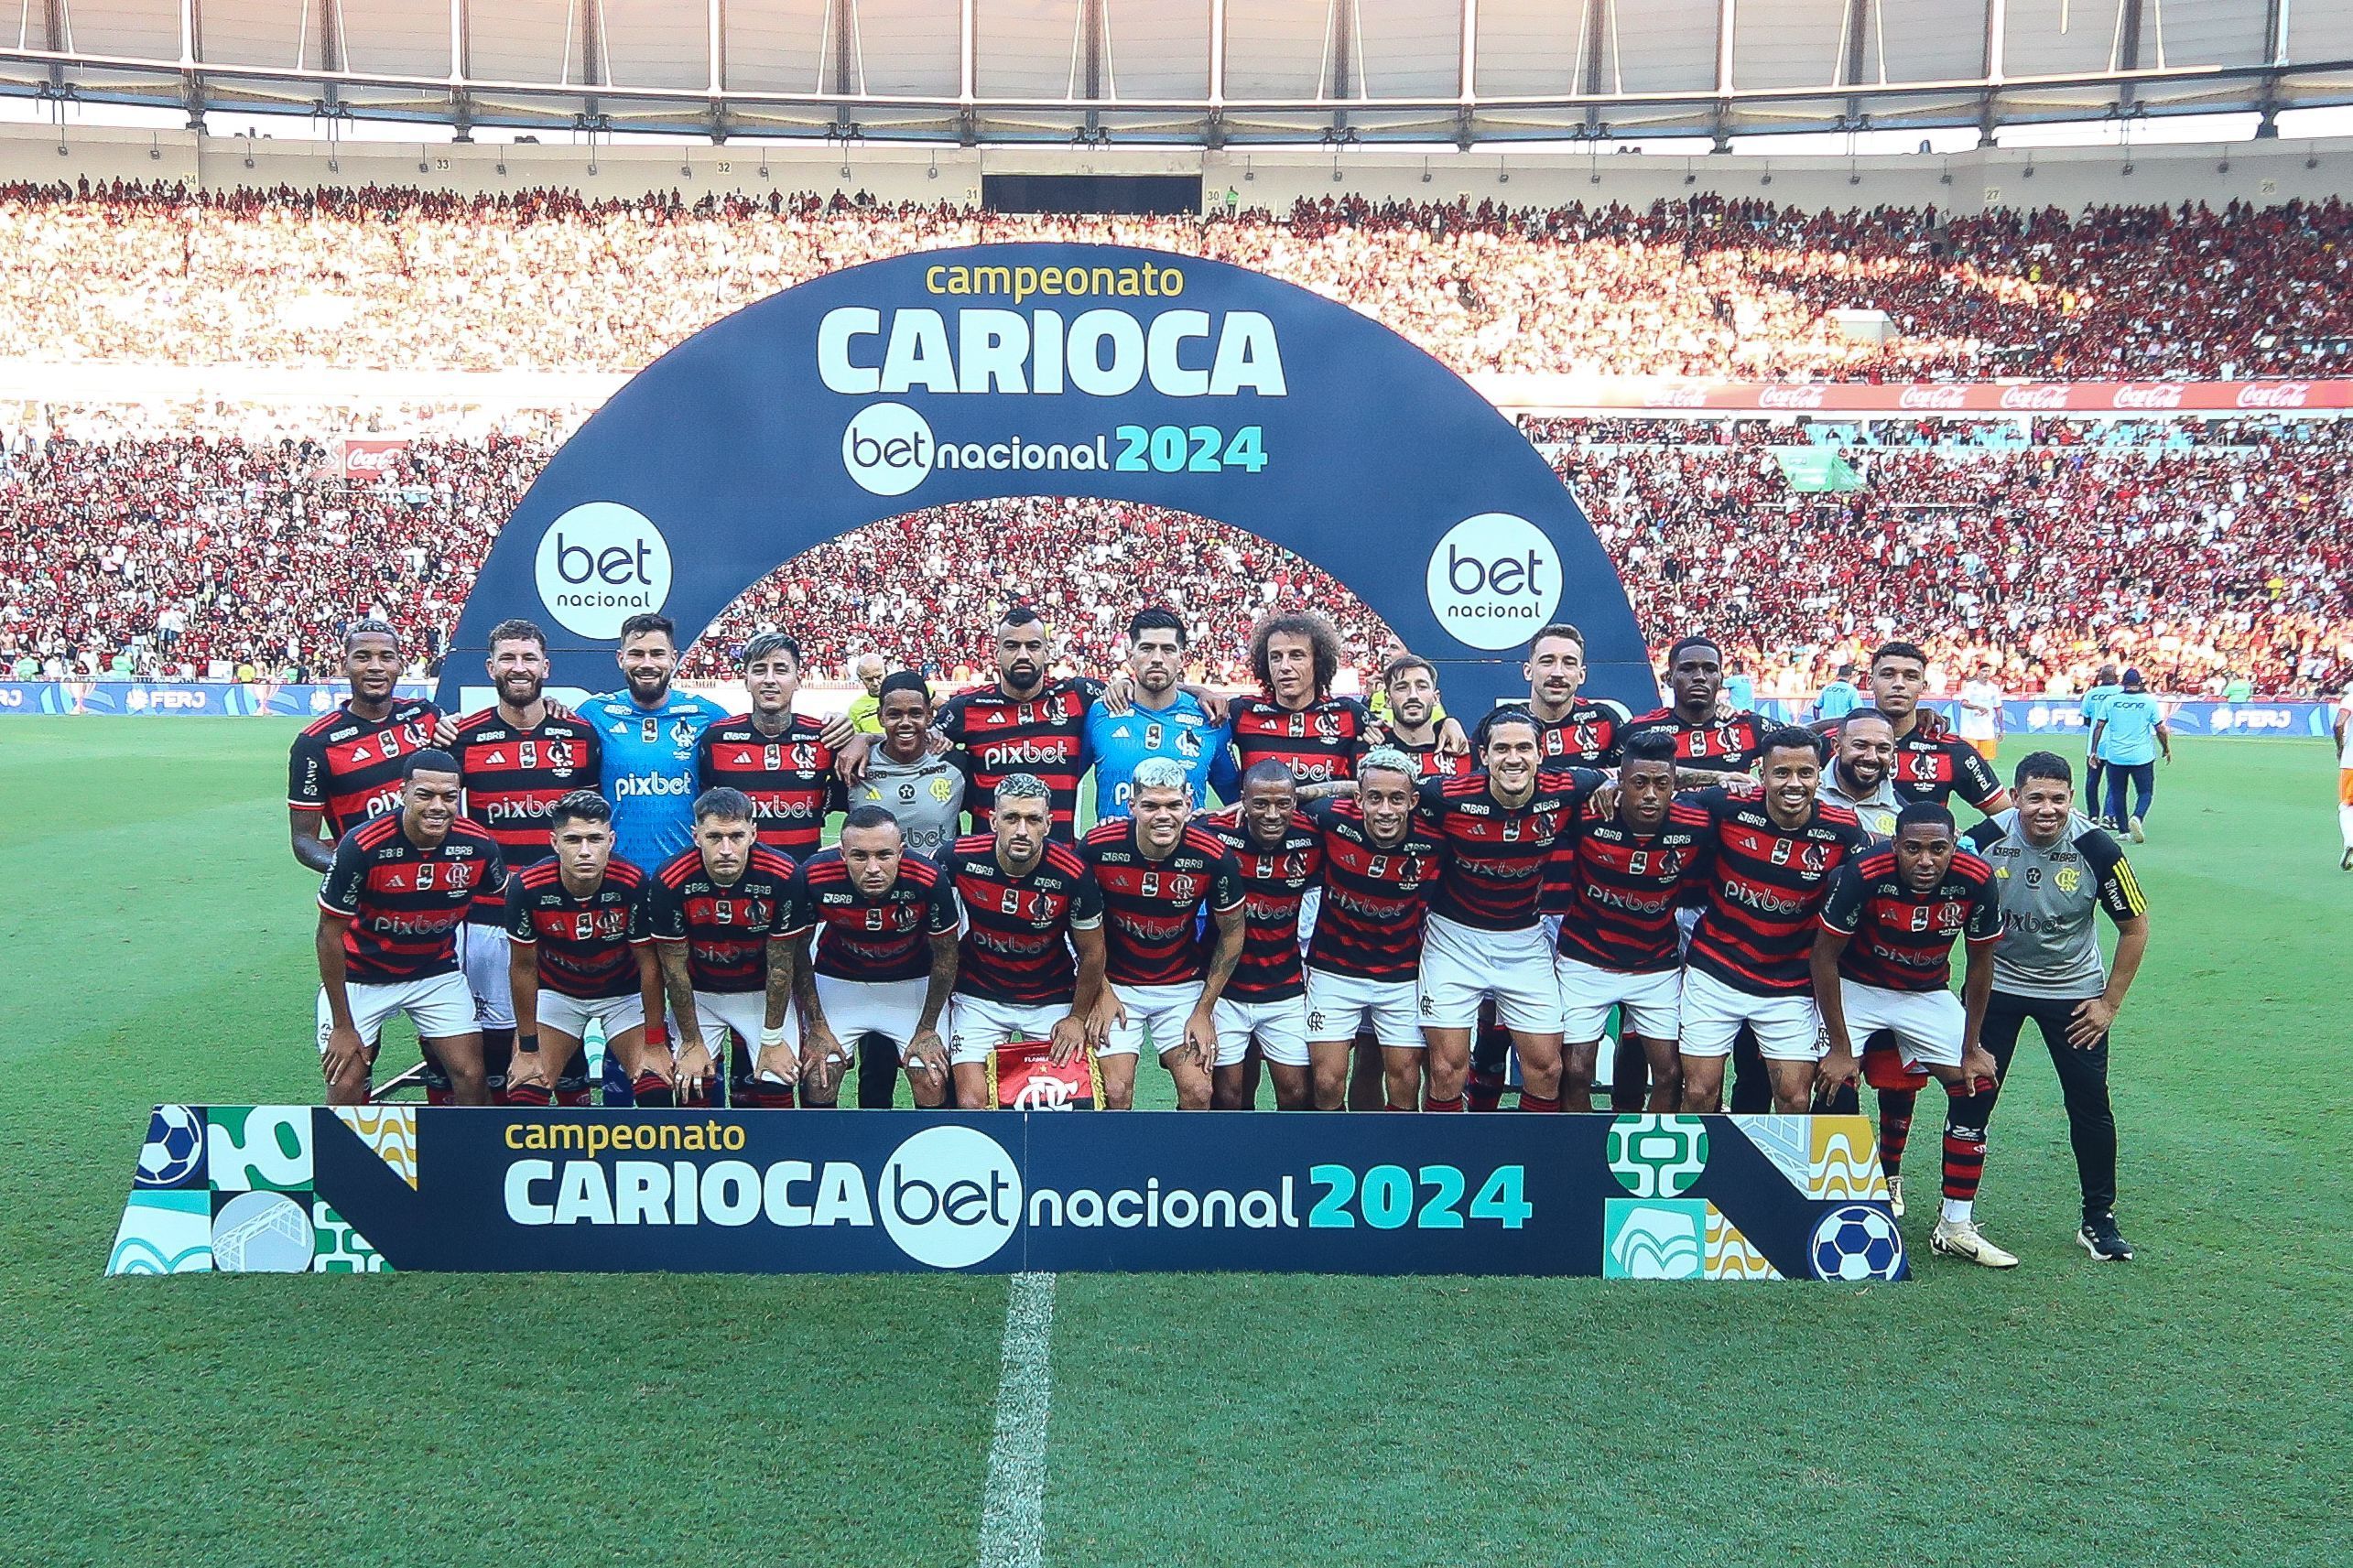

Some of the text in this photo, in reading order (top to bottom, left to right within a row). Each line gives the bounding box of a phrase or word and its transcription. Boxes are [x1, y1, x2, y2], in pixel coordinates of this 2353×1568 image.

[437, 159, 450, 169] 33
[718, 162, 731, 172] 32
[184, 174, 197, 186] 34
[966, 189, 978, 200] 31
[1208, 190, 1220, 200] 30
[926, 262, 1184, 304] campeonato
[817, 307, 1289, 396] CARIOCA
[1899, 385, 1969, 409] Coca-Cola
[2000, 385, 2071, 409] Coca-Cola
[2113, 384, 2185, 408] Coca-Cola
[2237, 384, 2311, 408] Coca-Cola
[851, 425, 1268, 473] bet nacional 2024
[558, 533, 651, 585] bet
[1449, 544, 1543, 596] bet
[558, 591, 650, 608] nacional
[1448, 601, 1541, 618] nacional
[150, 690, 207, 708] FERJ
[2235, 708, 2292, 729] FERJ
[985, 741, 1068, 770] pixbet
[1285, 755, 1334, 781] bet
[615, 771, 692, 802] pixbet
[368, 789, 406, 820] pix
[751, 795, 814, 827] ixbet
[902, 825, 947, 848] bet
[1588, 884, 1669, 914] pixbet
[1724, 881, 1806, 914] pixbet
[1245, 900, 1296, 920] xbet
[504, 1119, 746, 1158] campeonato
[504, 1159, 1533, 1230] CARIOCA bet nacional 2024
